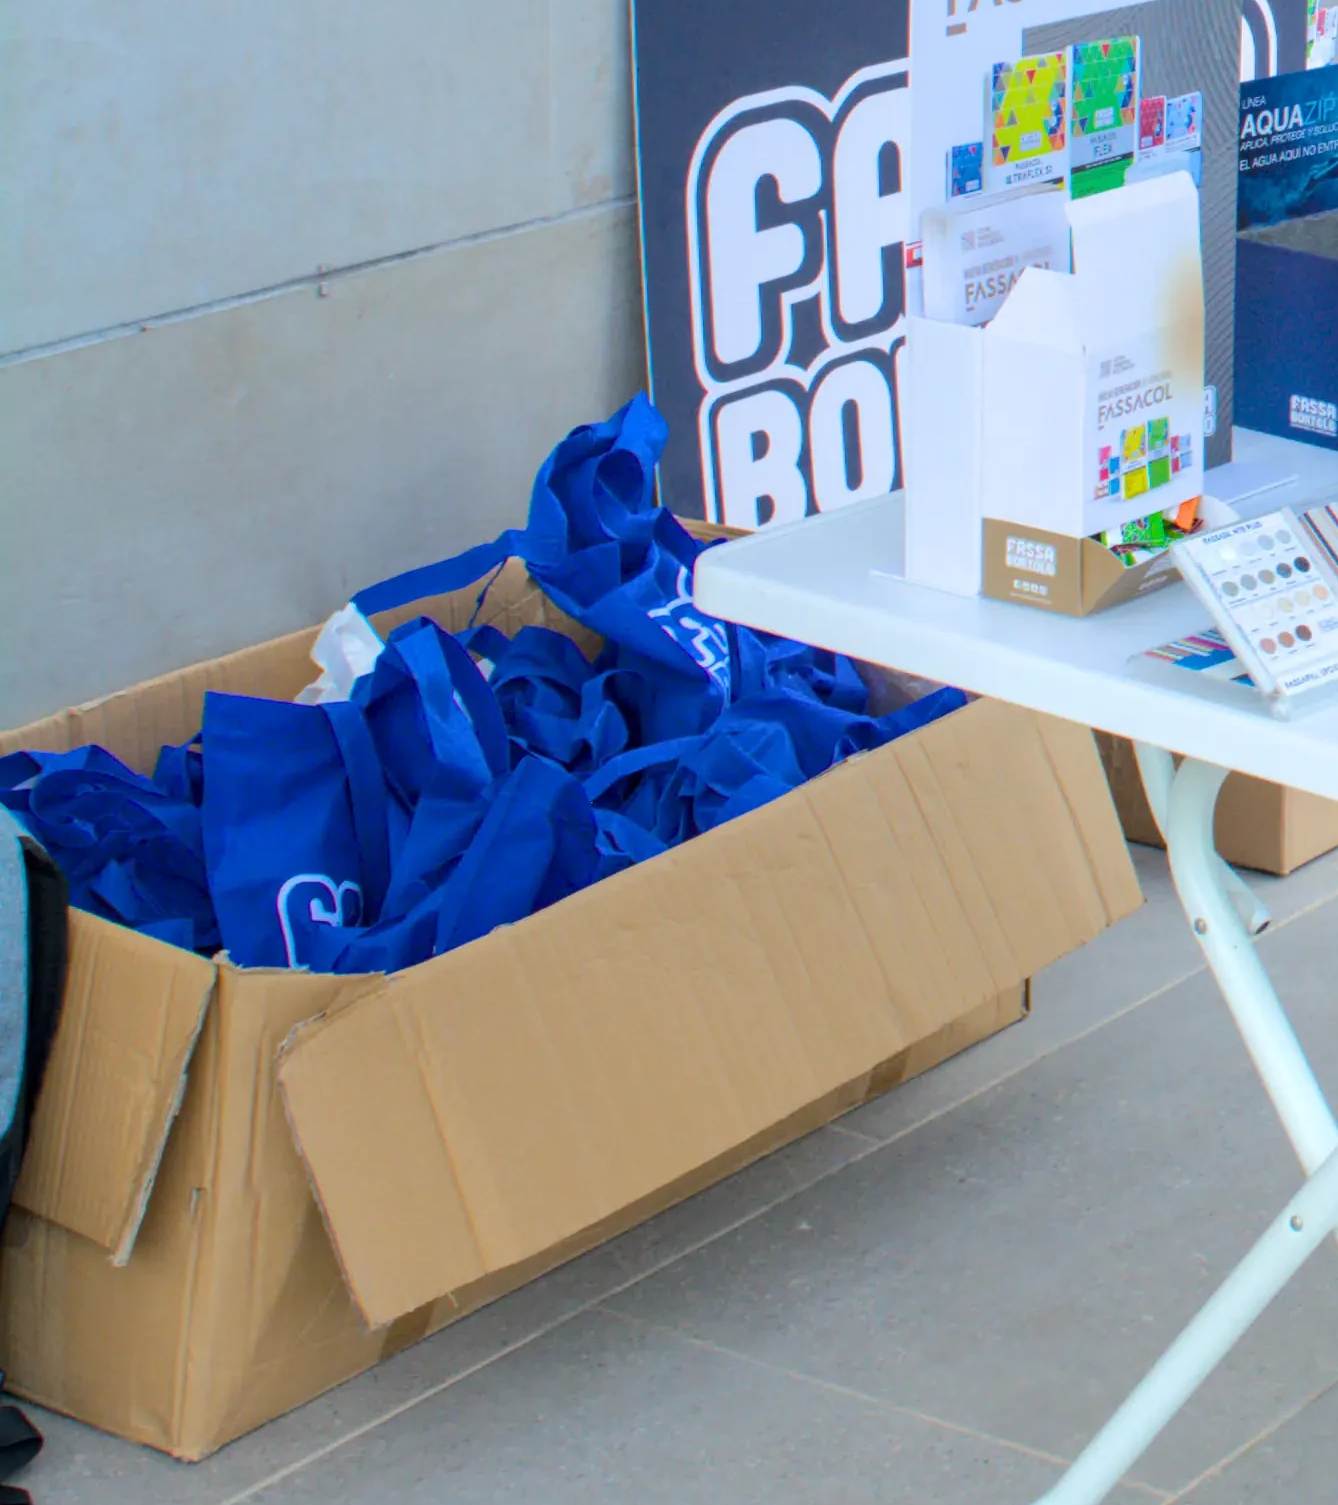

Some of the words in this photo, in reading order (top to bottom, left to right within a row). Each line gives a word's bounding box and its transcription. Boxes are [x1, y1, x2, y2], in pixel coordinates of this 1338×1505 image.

[1240, 97, 1337, 139] AQUAZIP
[1239, 158, 1251, 171] EL
[1252, 153, 1280, 169] AGUA
[1302, 143, 1317, 157] NO
[1098, 382, 1173, 425] FASSACOL
[1290, 394, 1338, 421] FASSA
[1006, 536, 1056, 563] FASSA
